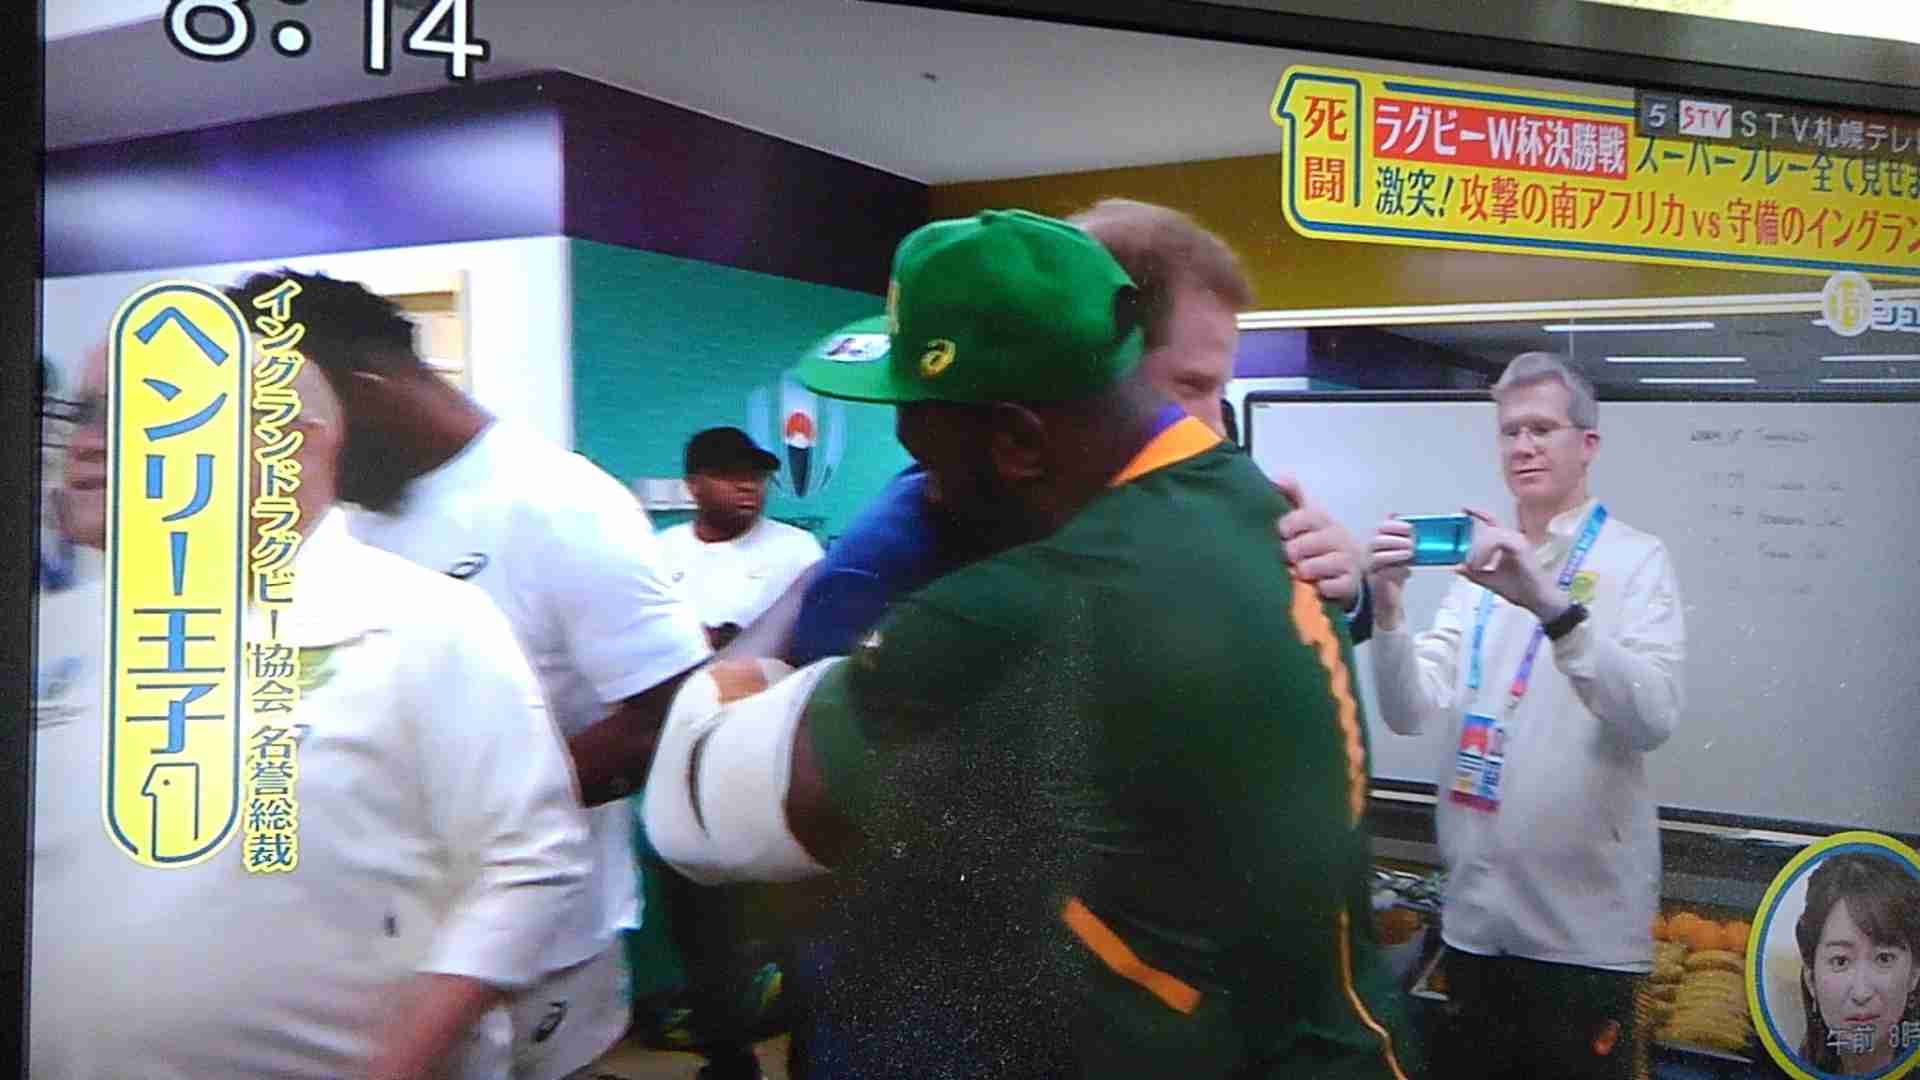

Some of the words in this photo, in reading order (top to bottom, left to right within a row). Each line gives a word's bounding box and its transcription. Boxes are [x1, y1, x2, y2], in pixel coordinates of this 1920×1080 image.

[1304, 96, 1348, 204] 死闘
[1375, 104, 1626, 173] ラグビーW杯決勝戦
[1649, 104, 1670, 128] 5
[1682, 105, 1731, 130] STV
[1740, 109, 1920, 153] STV札幌テレ
[127, 306, 229, 755] ヘンリー王子
[249, 281, 304, 714] イングランドラグビー協会
[248, 724, 298, 868] 名誉総裁
[1826, 1024, 1874, 1056] 午前
